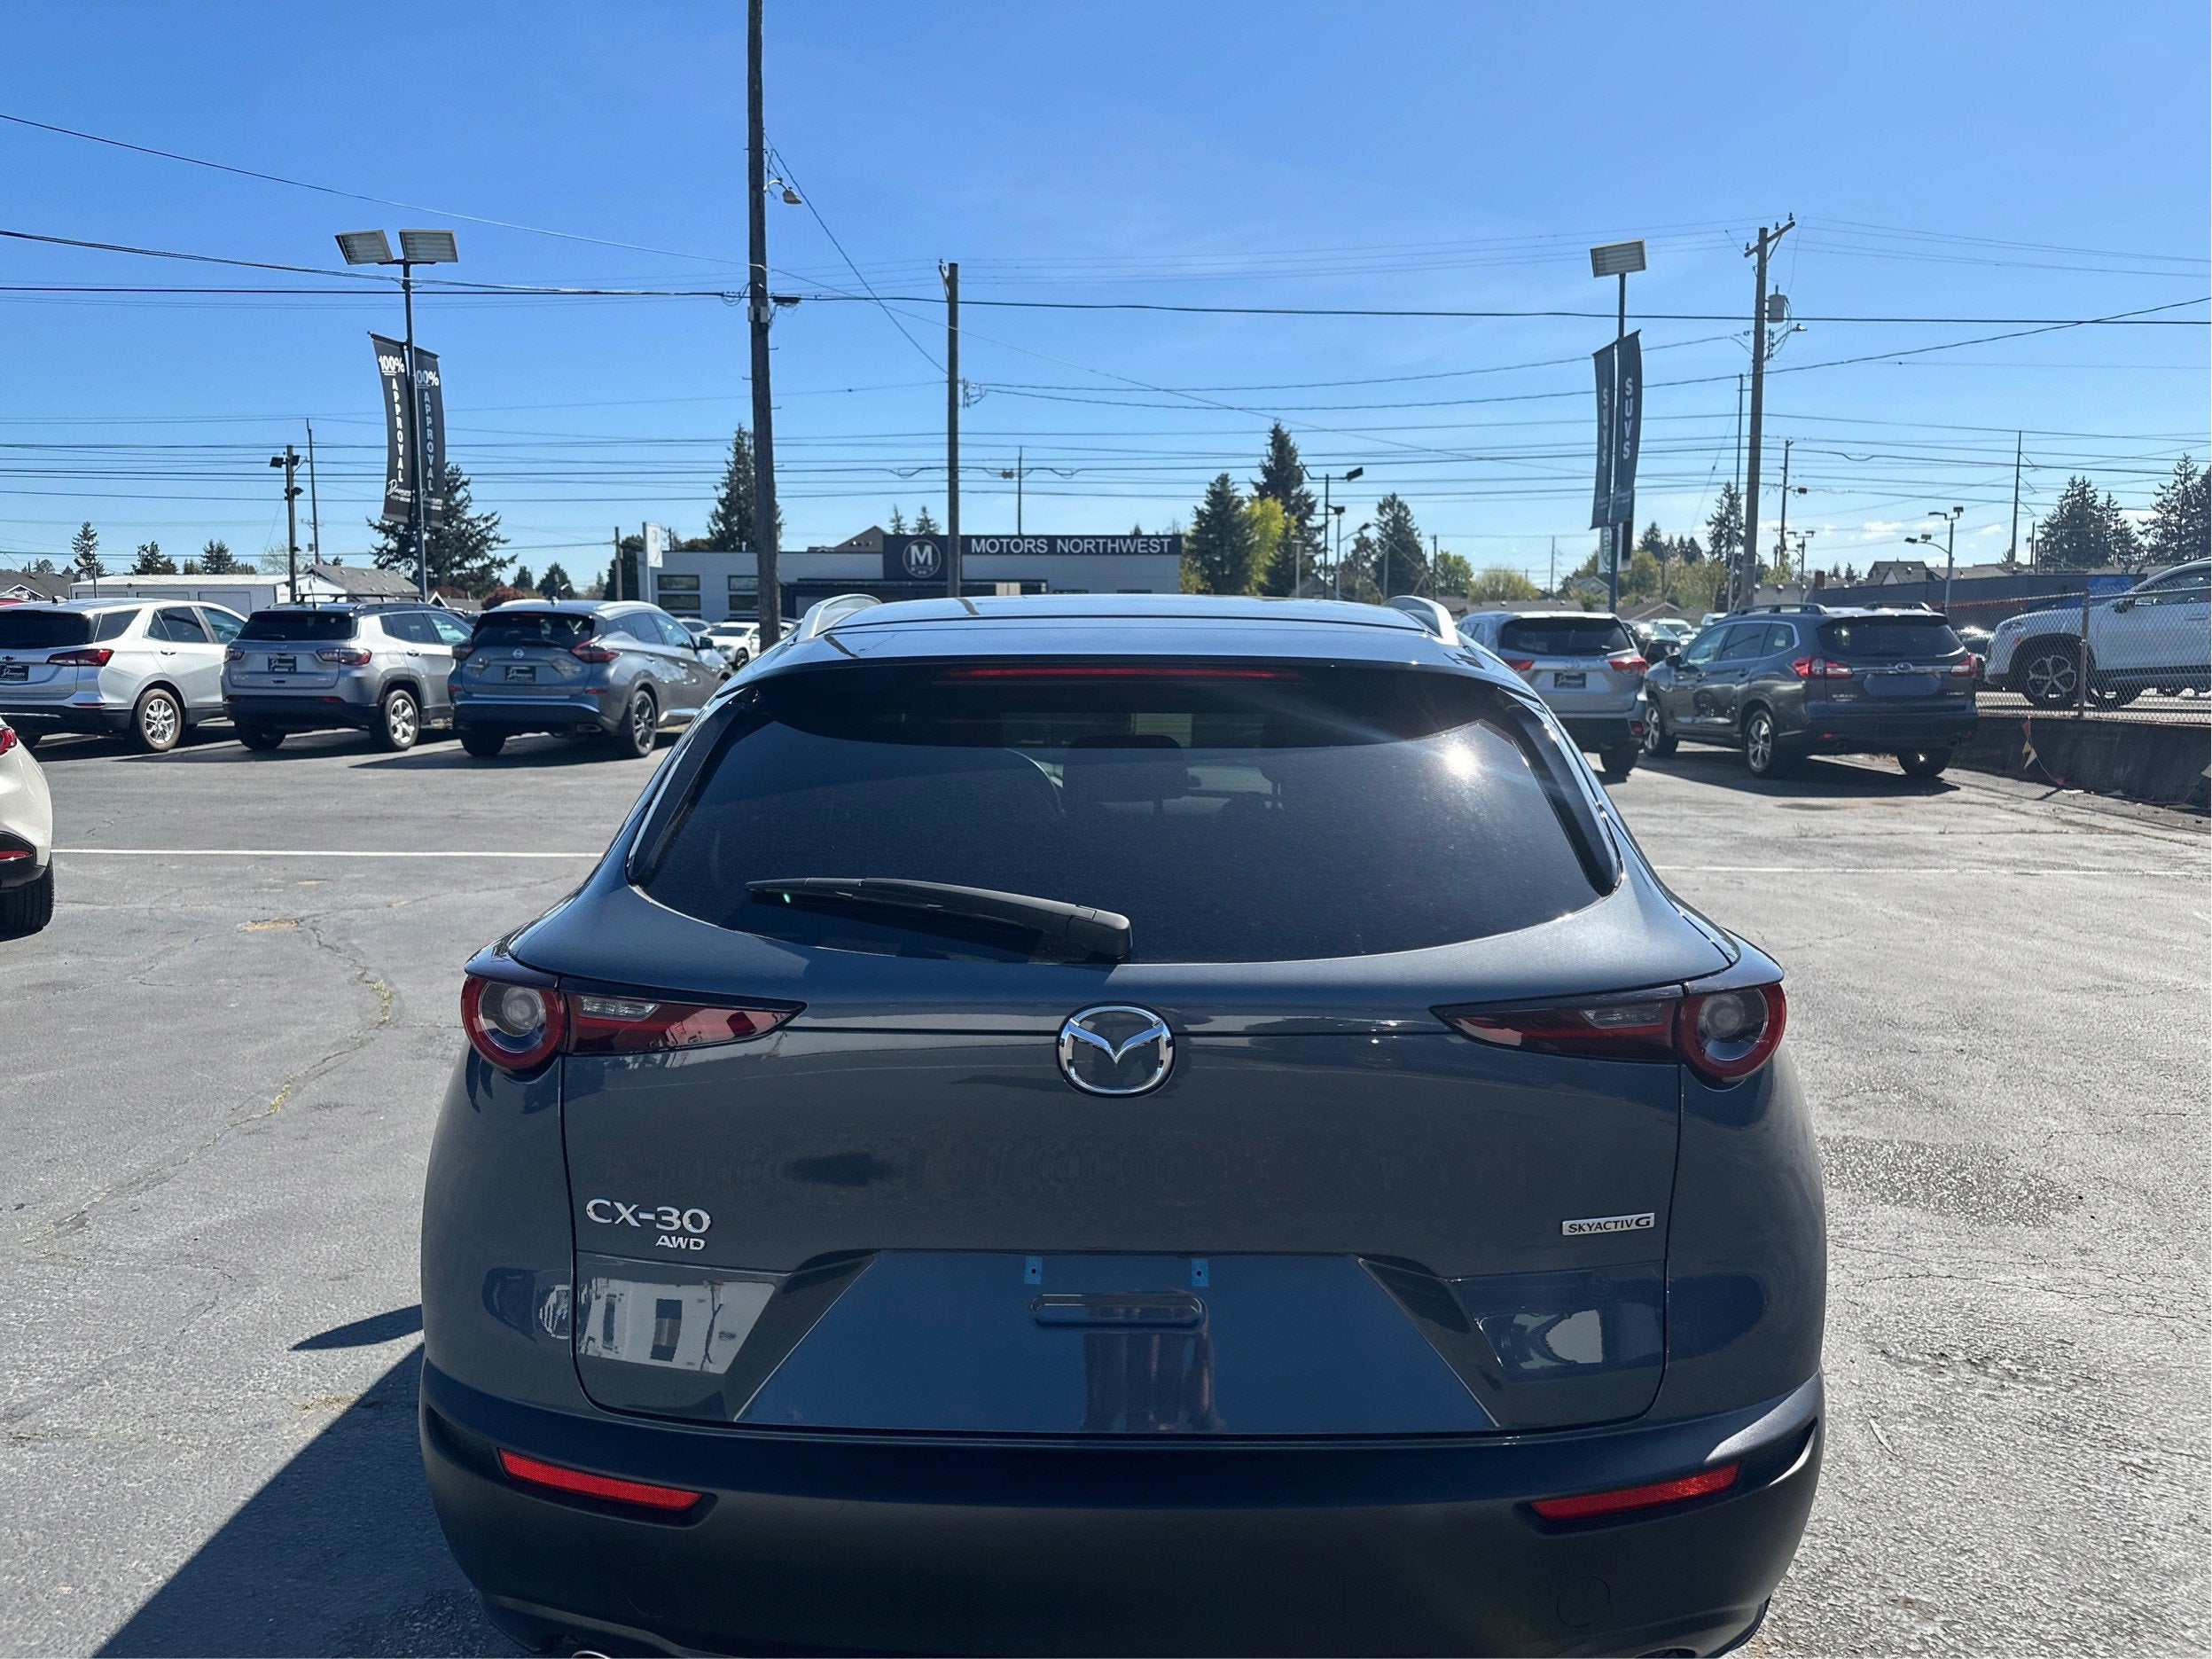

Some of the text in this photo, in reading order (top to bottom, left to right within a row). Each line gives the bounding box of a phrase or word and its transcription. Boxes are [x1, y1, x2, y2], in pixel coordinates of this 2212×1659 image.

[379, 355, 405, 373] 100%
[413, 369, 440, 387] 00%
[1622, 377, 1633, 460] SUVS
[392, 378, 404, 482] APPROVAL
[424, 391, 434, 492] APPROVAL
[911, 544, 933, 566] M
[971, 537, 1172, 554] MOTORS NORTHWEST
[586, 1198, 711, 1233] CX-30
[655, 1235, 707, 1251] AWD
